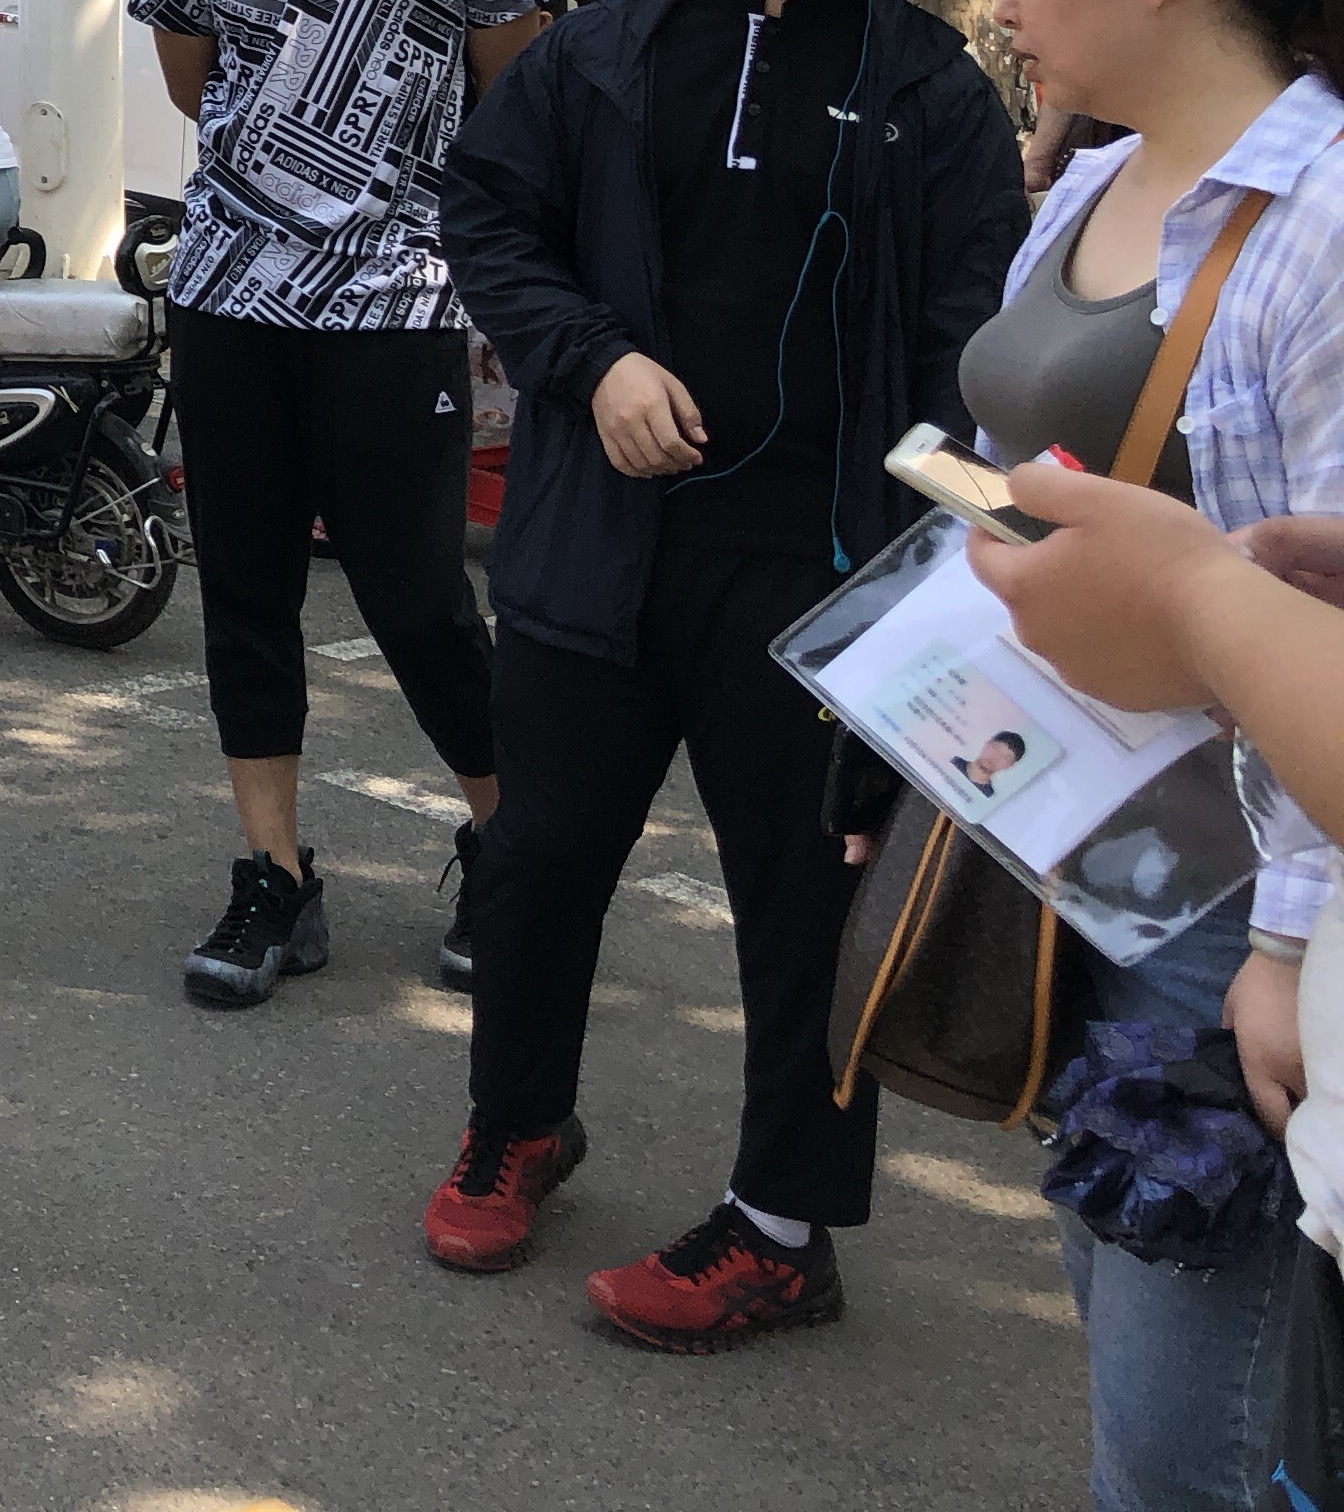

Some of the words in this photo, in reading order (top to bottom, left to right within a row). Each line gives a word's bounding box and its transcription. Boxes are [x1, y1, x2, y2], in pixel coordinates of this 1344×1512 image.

[380, 0, 410, 51] adidas
[262, 18, 327, 113] SPRT
[366, 51, 387, 81] neo
[394, 38, 447, 82] SPRT
[236, 102, 276, 175] adidas
[338, 80, 382, 148] SPRT
[369, 120, 394, 158] THREE
[388, 71, 415, 120] STRIPES
[261, 173, 345, 225] adidas
[275, 153, 319, 182] ADIDAS
[318, 174, 329, 189] X
[330, 180, 357, 201] NEO
[230, 263, 246, 282] NEO
